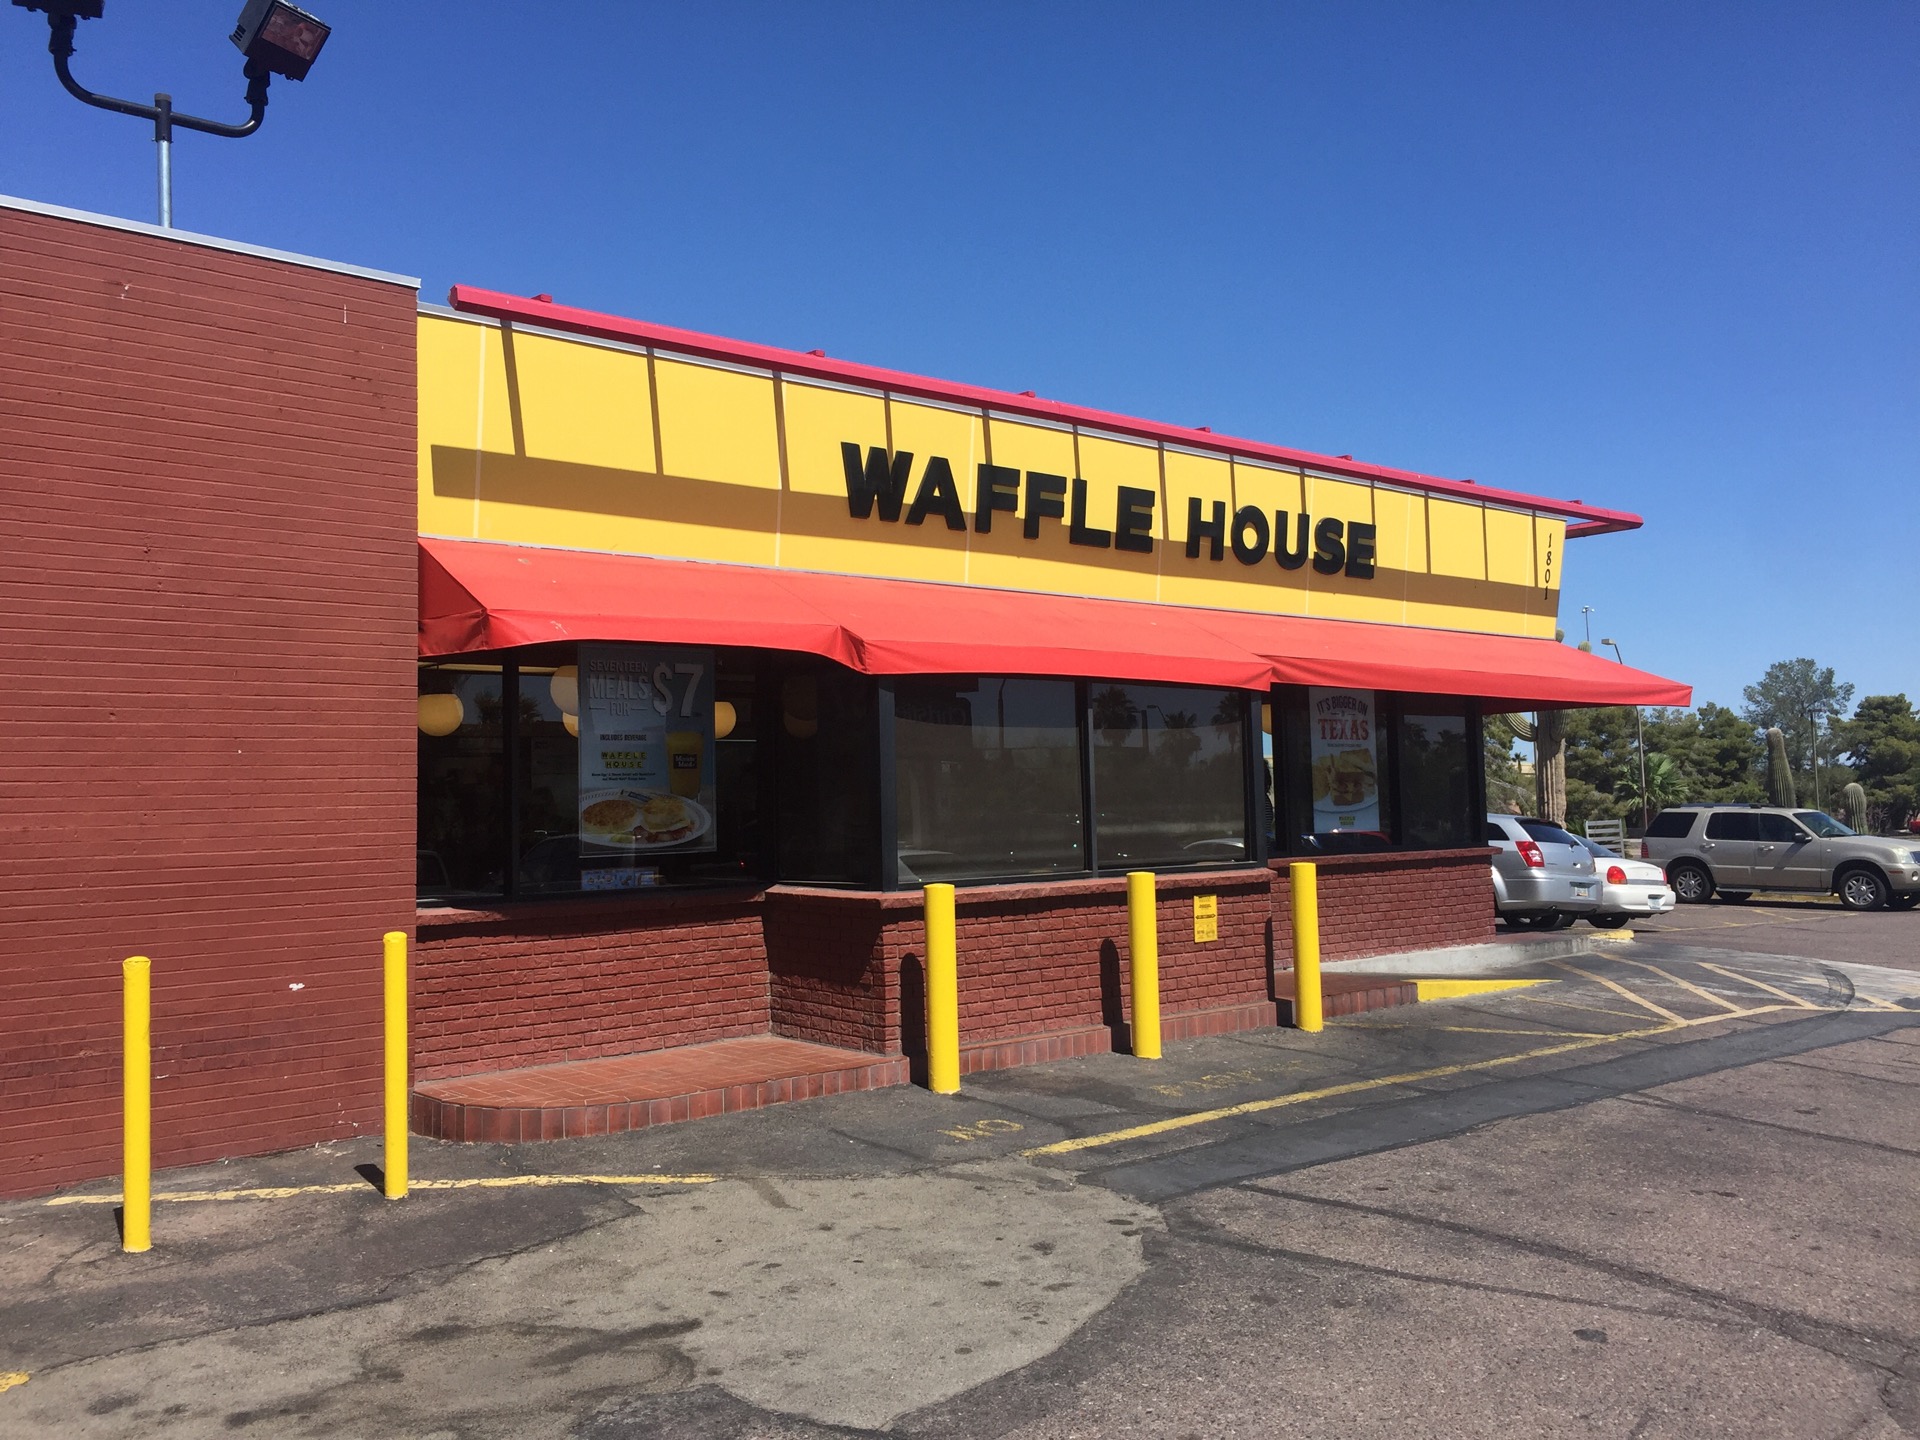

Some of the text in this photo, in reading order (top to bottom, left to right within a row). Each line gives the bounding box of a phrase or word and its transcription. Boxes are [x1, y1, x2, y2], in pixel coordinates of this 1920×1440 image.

[841, 441, 1376, 580] WAFFLE HOUSE
[1544, 532, 1552, 601] 1801
[589, 660, 648, 673] SEVENTEEN
[588, 672, 650, 700] MEALS
[652, 661, 705, 718] $7
[609, 701, 630, 717] FOR
[1316, 695, 1369, 716] IT'S BIGGER ON
[1318, 718, 1369, 741] TEXAS
[601, 751, 647, 760] WAFFLE
[605, 760, 643, 769] HOUSE
